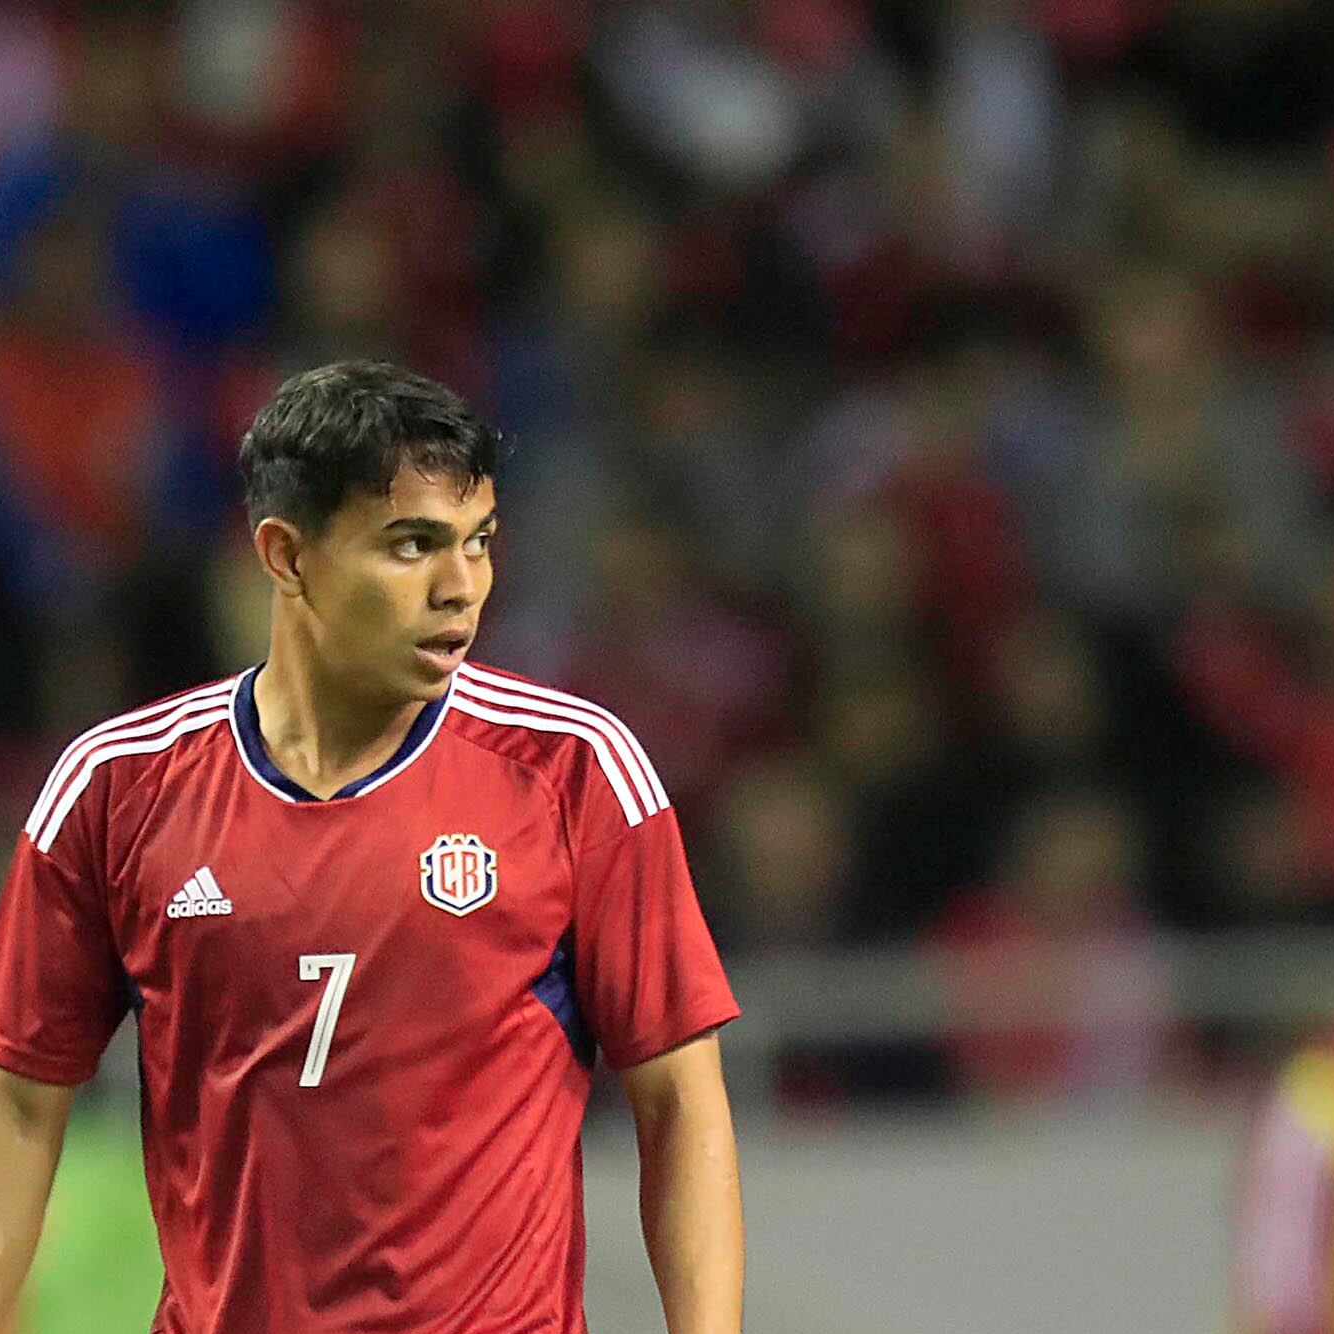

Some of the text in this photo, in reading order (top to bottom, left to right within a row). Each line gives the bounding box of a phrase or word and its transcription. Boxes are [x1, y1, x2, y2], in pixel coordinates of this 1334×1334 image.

[439, 851, 479, 899] CR
[167, 898, 232, 918] adidas
[298, 953, 357, 1088] 7
